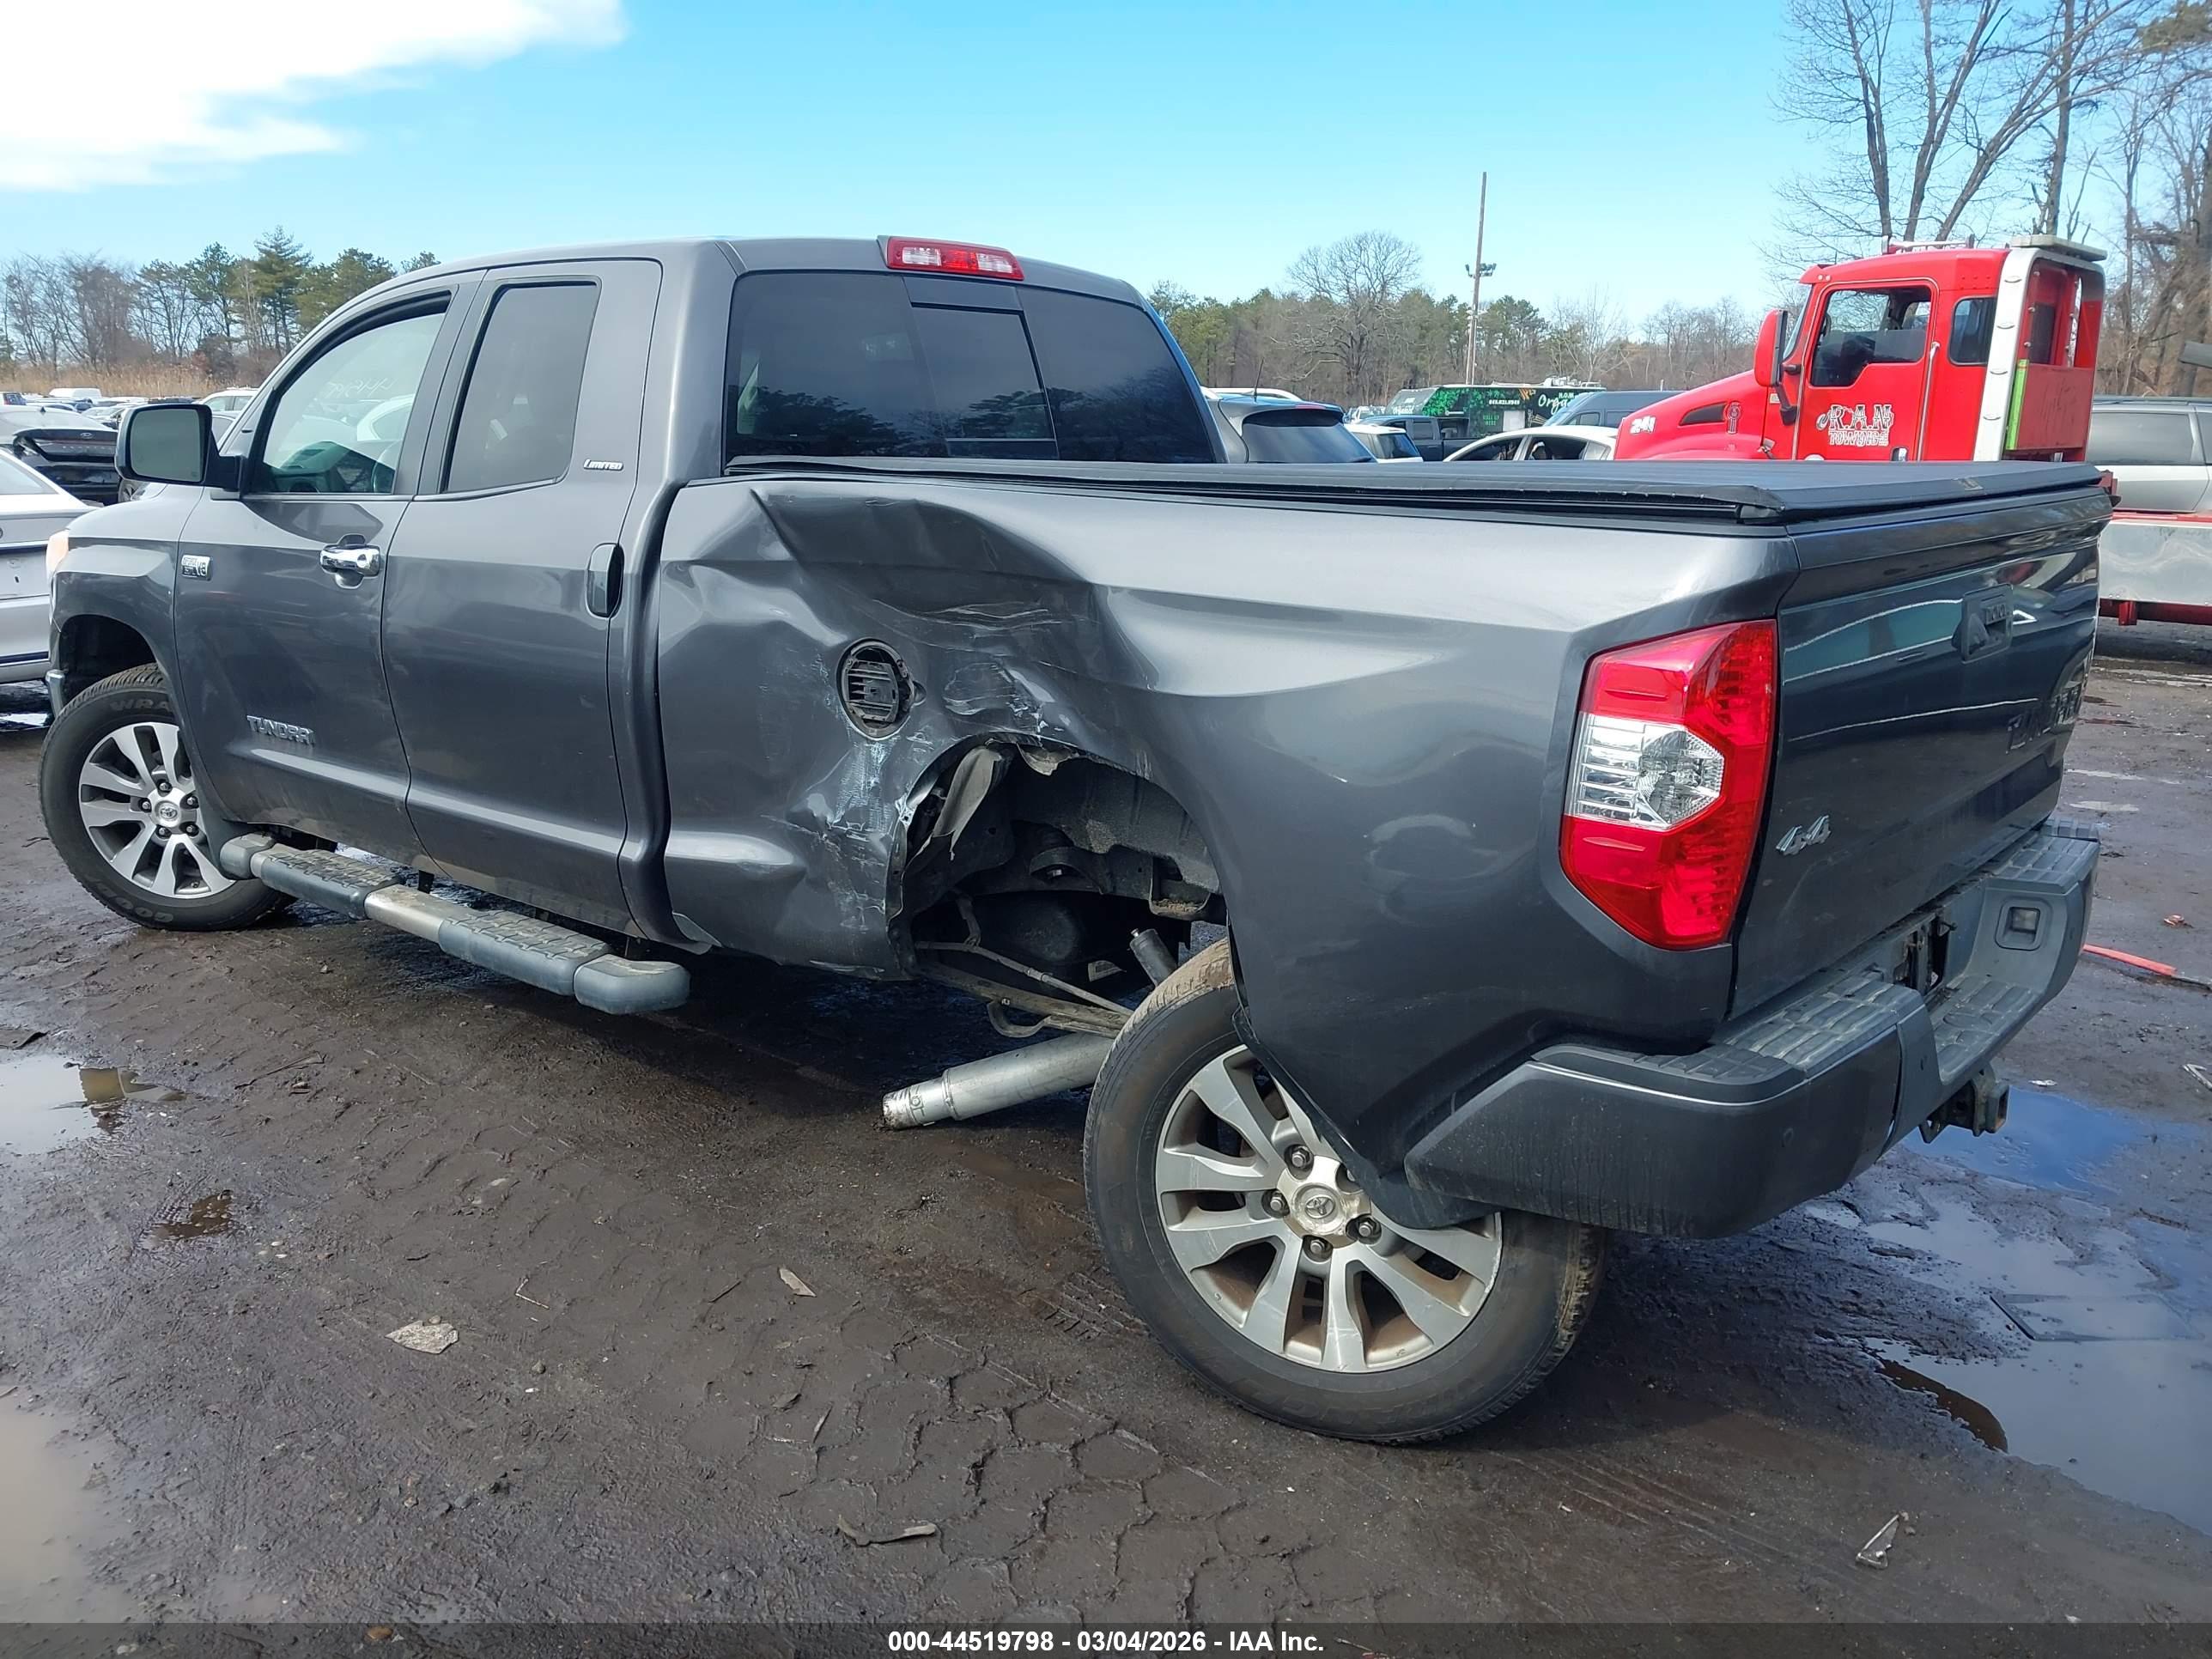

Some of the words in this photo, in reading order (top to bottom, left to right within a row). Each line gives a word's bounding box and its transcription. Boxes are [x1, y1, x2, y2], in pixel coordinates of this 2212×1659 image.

[1538, 394, 1569, 415] Orga
[110, 698, 170, 712] WRA
[246, 714, 314, 746] TUNDRA
